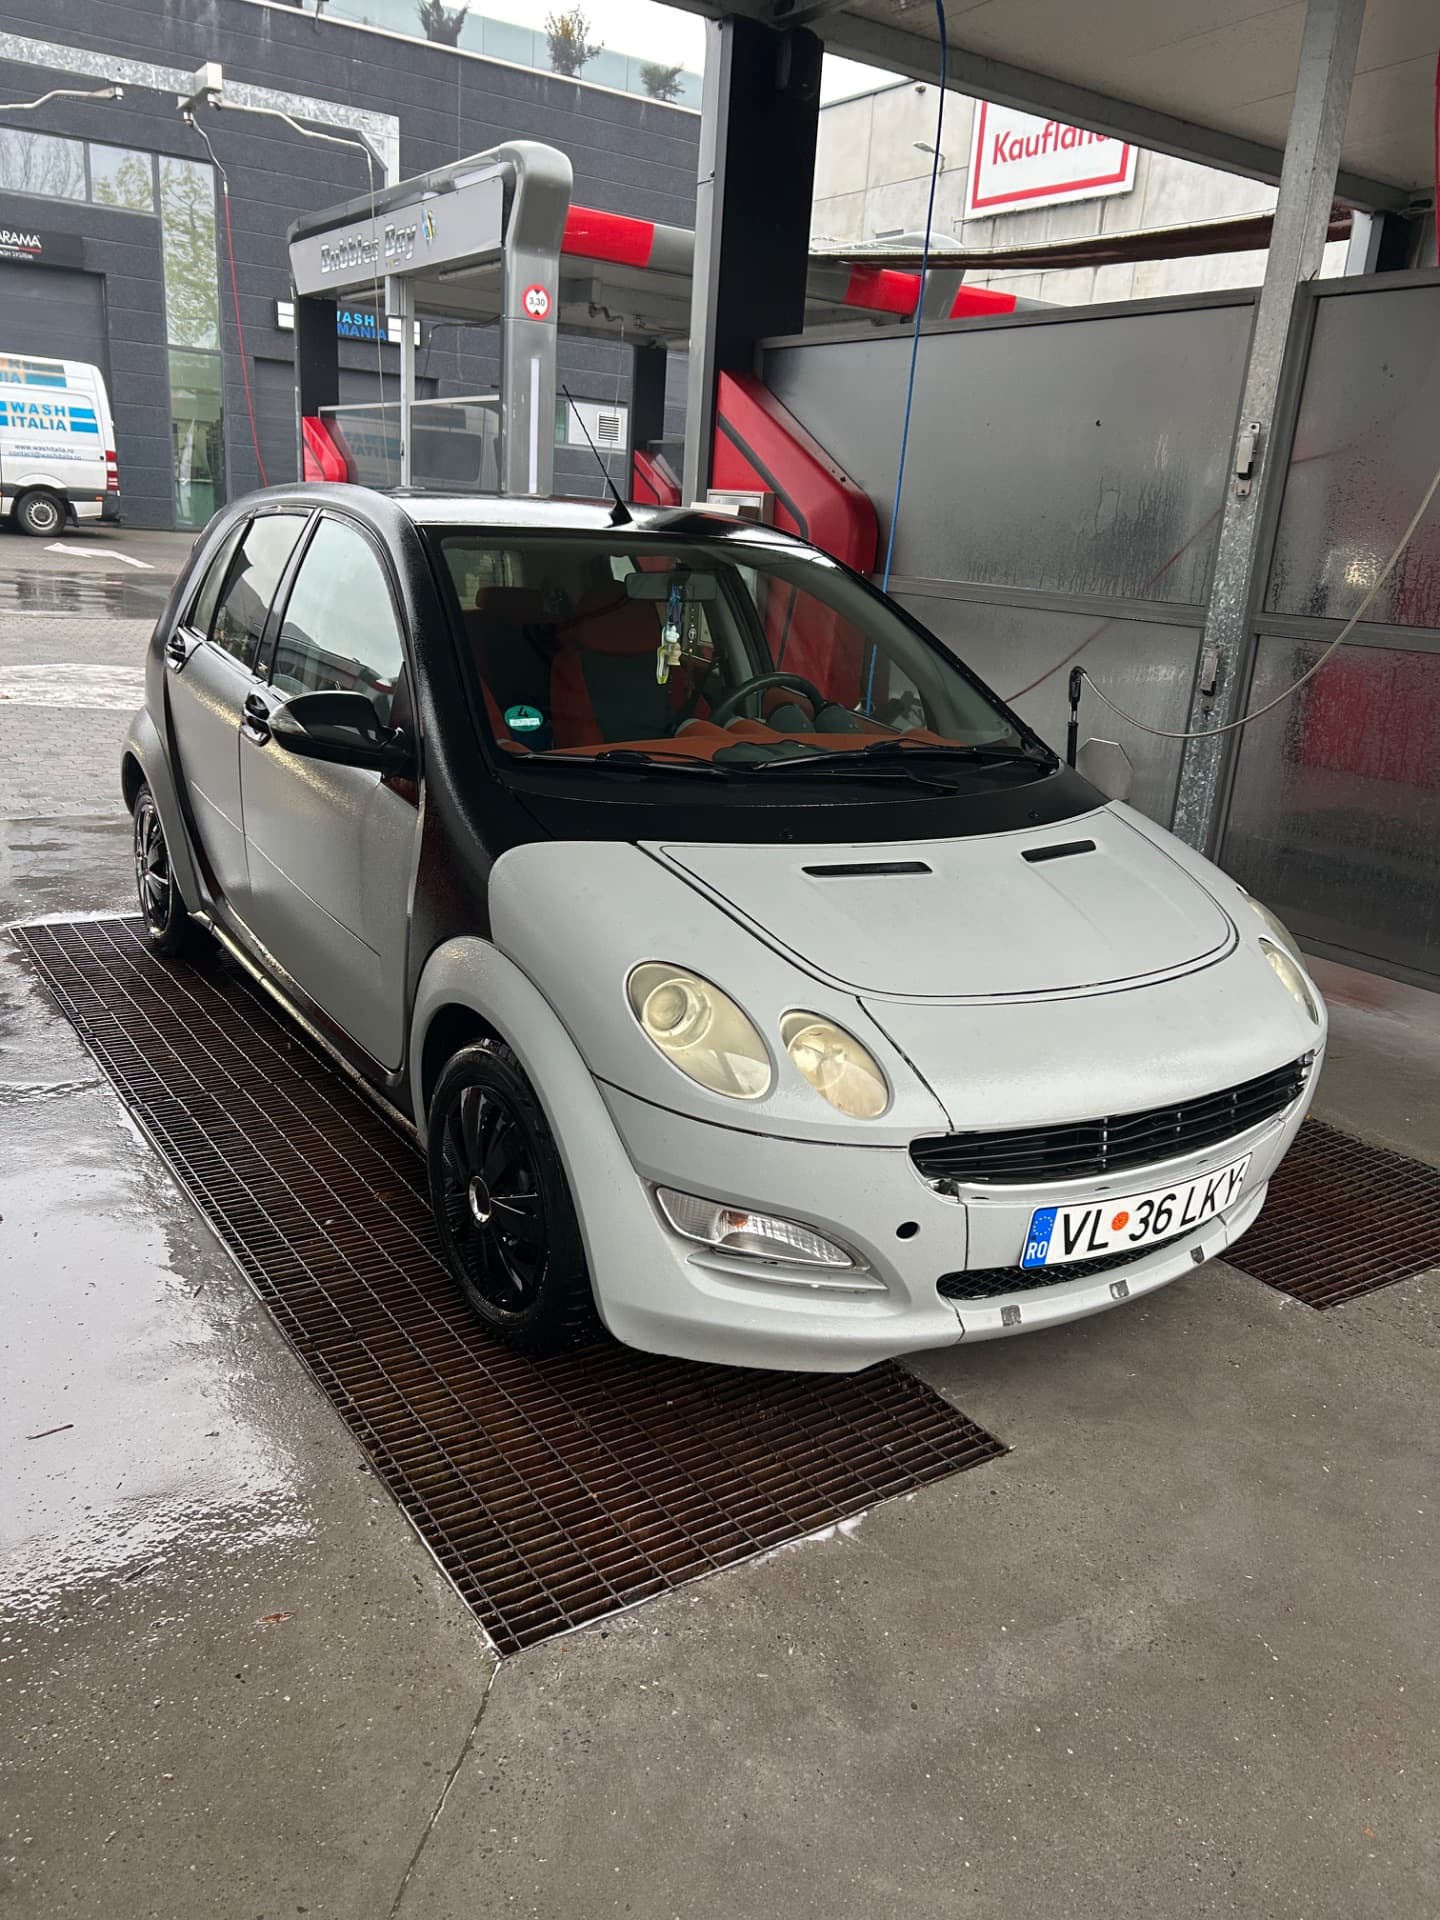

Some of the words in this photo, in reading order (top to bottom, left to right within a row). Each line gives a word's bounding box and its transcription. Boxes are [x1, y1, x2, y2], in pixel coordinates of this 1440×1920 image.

[337, 310, 376, 328] ASH
[337, 323, 387, 341] MANIA
[10, 400, 66, 417] WASH
[11, 415, 67, 432] ITALIA
[517, 705, 529, 717] 4
[1063, 1208, 1109, 1255] VL
[1128, 1193, 1176, 1242] 36
[1179, 1162, 1246, 1227] LKY
[1026, 1240, 1047, 1260] RO
